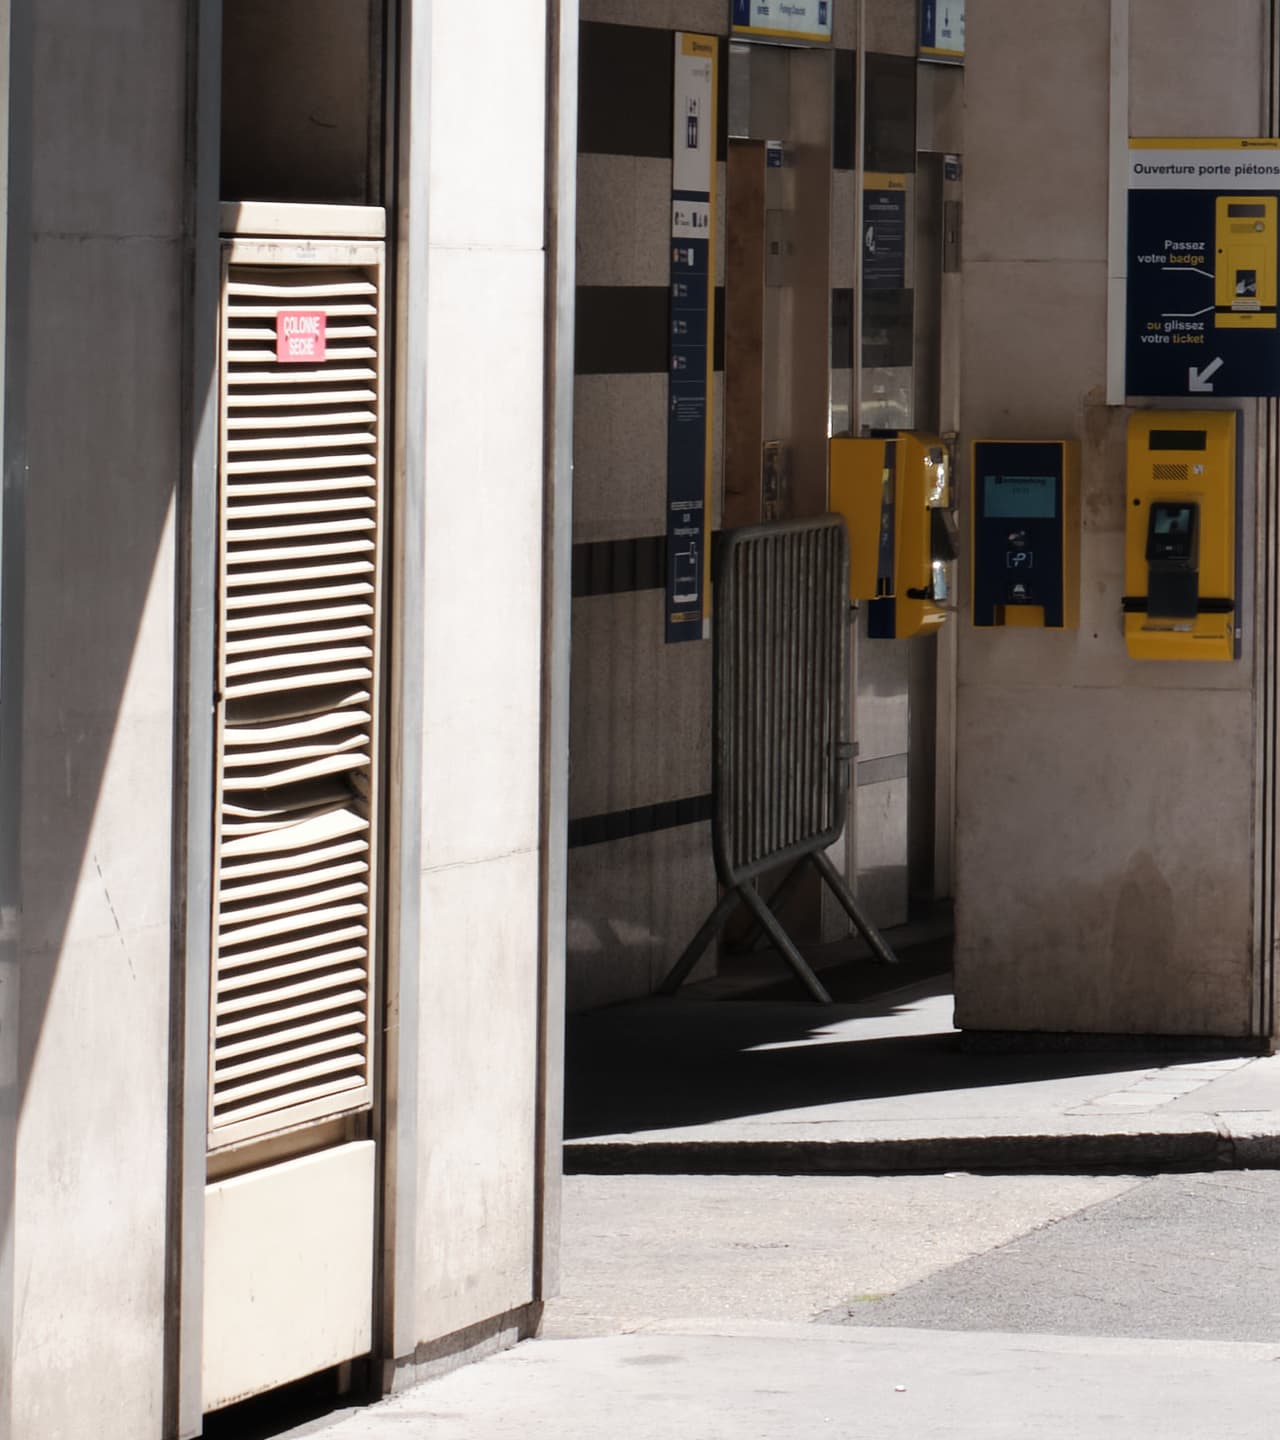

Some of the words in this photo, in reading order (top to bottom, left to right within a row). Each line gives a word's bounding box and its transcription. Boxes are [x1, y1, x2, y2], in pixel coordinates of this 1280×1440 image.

[1133, 163, 1196, 176] Ouverture
[1198, 164, 1231, 177] porte
[1234, 163, 1280, 177] piétons
[1164, 239, 1206, 251] Passez
[1137, 254, 1167, 264] votre
[1169, 253, 1205, 266] badge
[283, 316, 320, 337] COLONNE
[1164, 320, 1205, 333] glissez
[1140, 334, 1170, 344] votre
[1172, 333, 1204, 344] ticket
